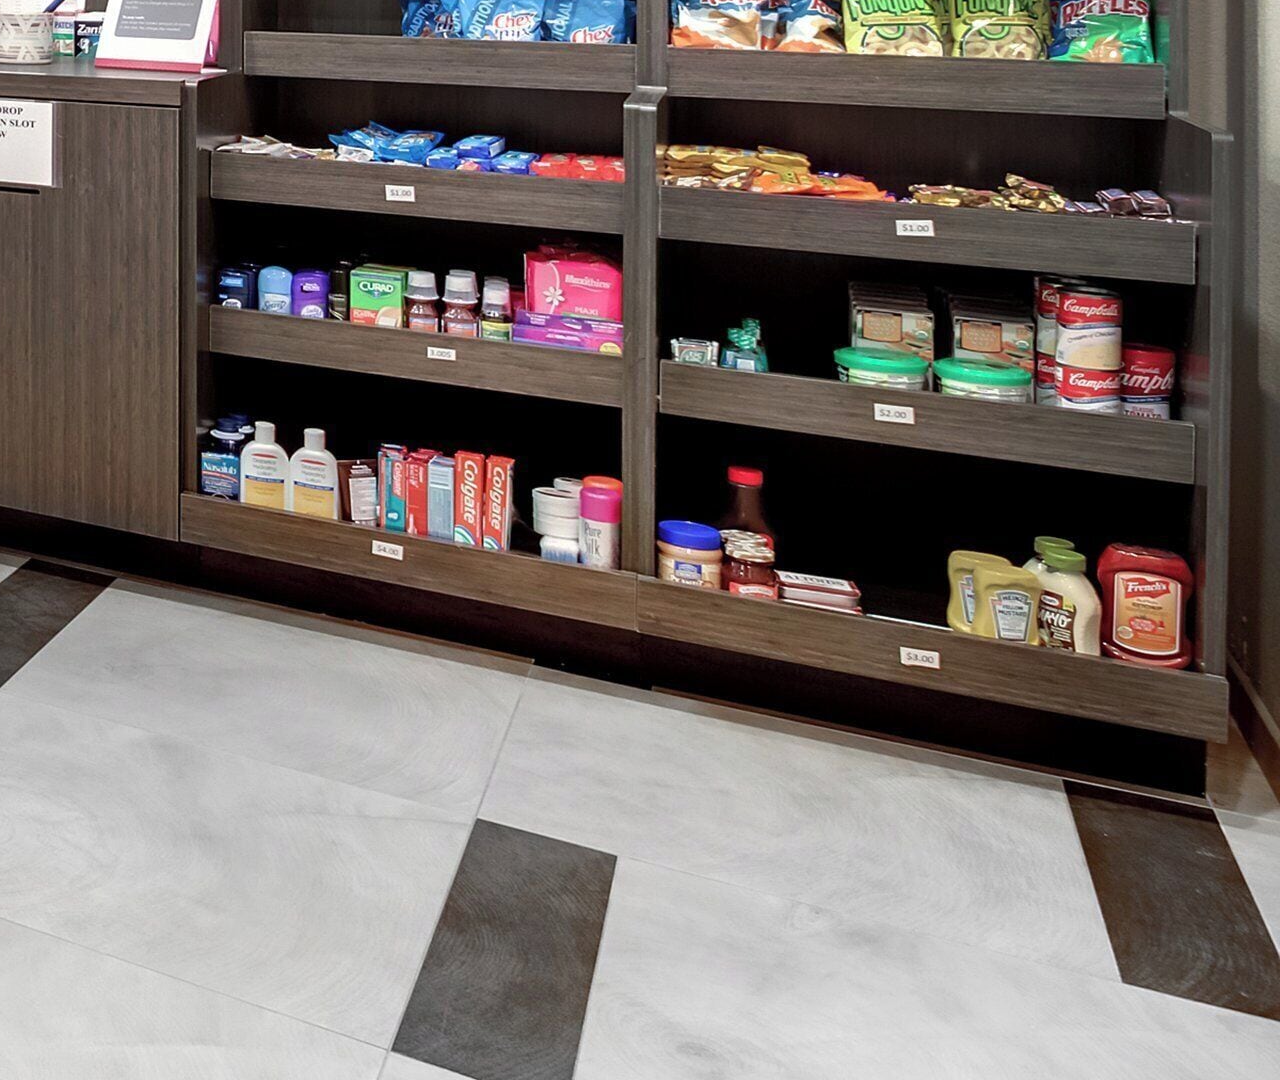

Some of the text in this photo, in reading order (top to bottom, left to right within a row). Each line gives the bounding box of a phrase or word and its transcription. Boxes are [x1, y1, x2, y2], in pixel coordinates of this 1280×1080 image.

[493, 11, 535, 28] Chex
[571, 26, 614, 43] Chex
[9, 119, 37, 128] SLOT
[390, 189, 412, 197] $1.00
[359, 281, 394, 293] CURAD
[574, 306, 599, 316] MAXI
[879, 409, 907, 418] $2.00
[393, 461, 404, 496] Colgate
[463, 459, 478, 524] Colgate
[489, 467, 505, 530] Colgate
[584, 523, 601, 538] Pure
[376, 548, 399, 556] $4.00
[1126, 581, 1168, 593] French's
[998, 610, 1027, 618] MUSTARD
[906, 653, 934, 663] $3.00
